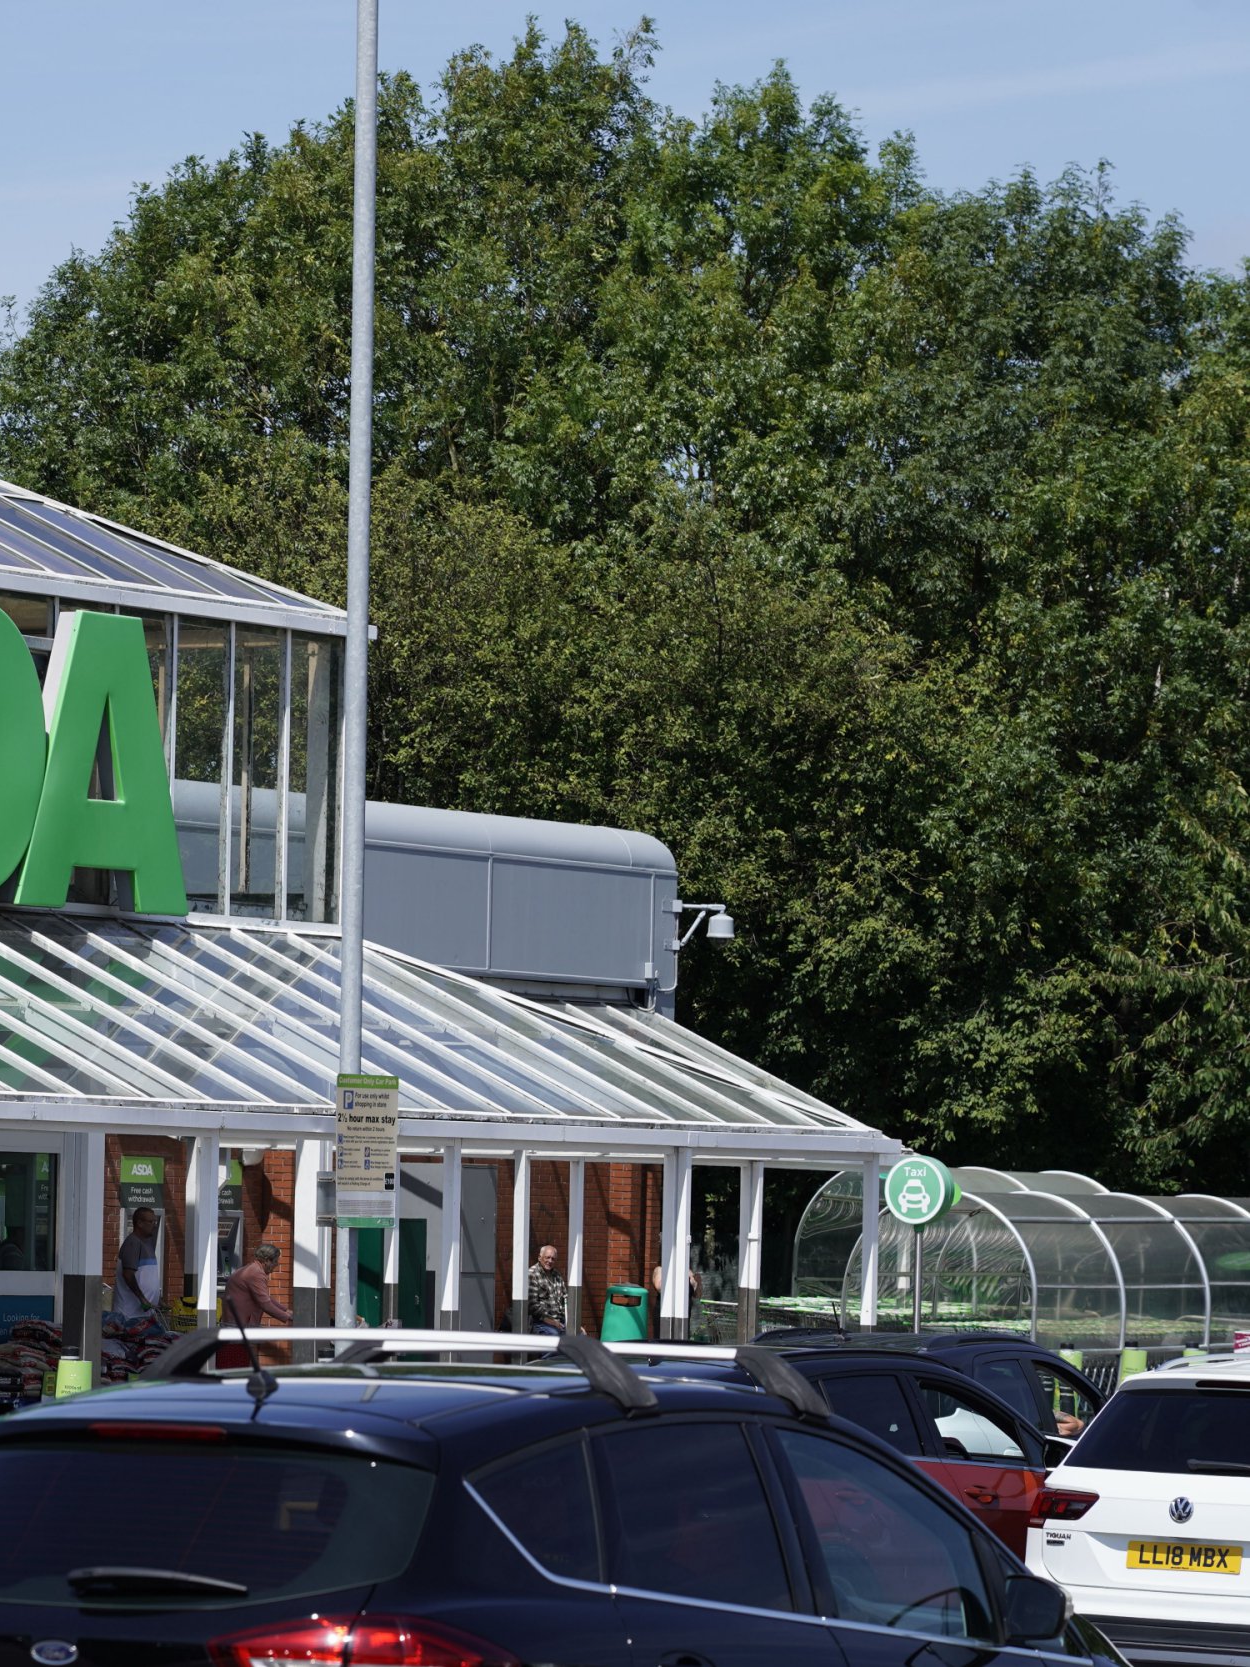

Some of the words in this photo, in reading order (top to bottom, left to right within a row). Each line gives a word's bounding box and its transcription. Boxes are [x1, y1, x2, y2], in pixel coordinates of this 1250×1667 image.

[349, 1114, 363, 1123] hour
[382, 1116, 396, 1126] stay
[132, 1164, 153, 1176] ASDA
[903, 1166, 927, 1177] Taxi
[1045, 1531, 1072, 1540] TIGUAN
[1138, 1543, 1184, 1566] LL18
[1189, 1546, 1230, 1569] MBX
